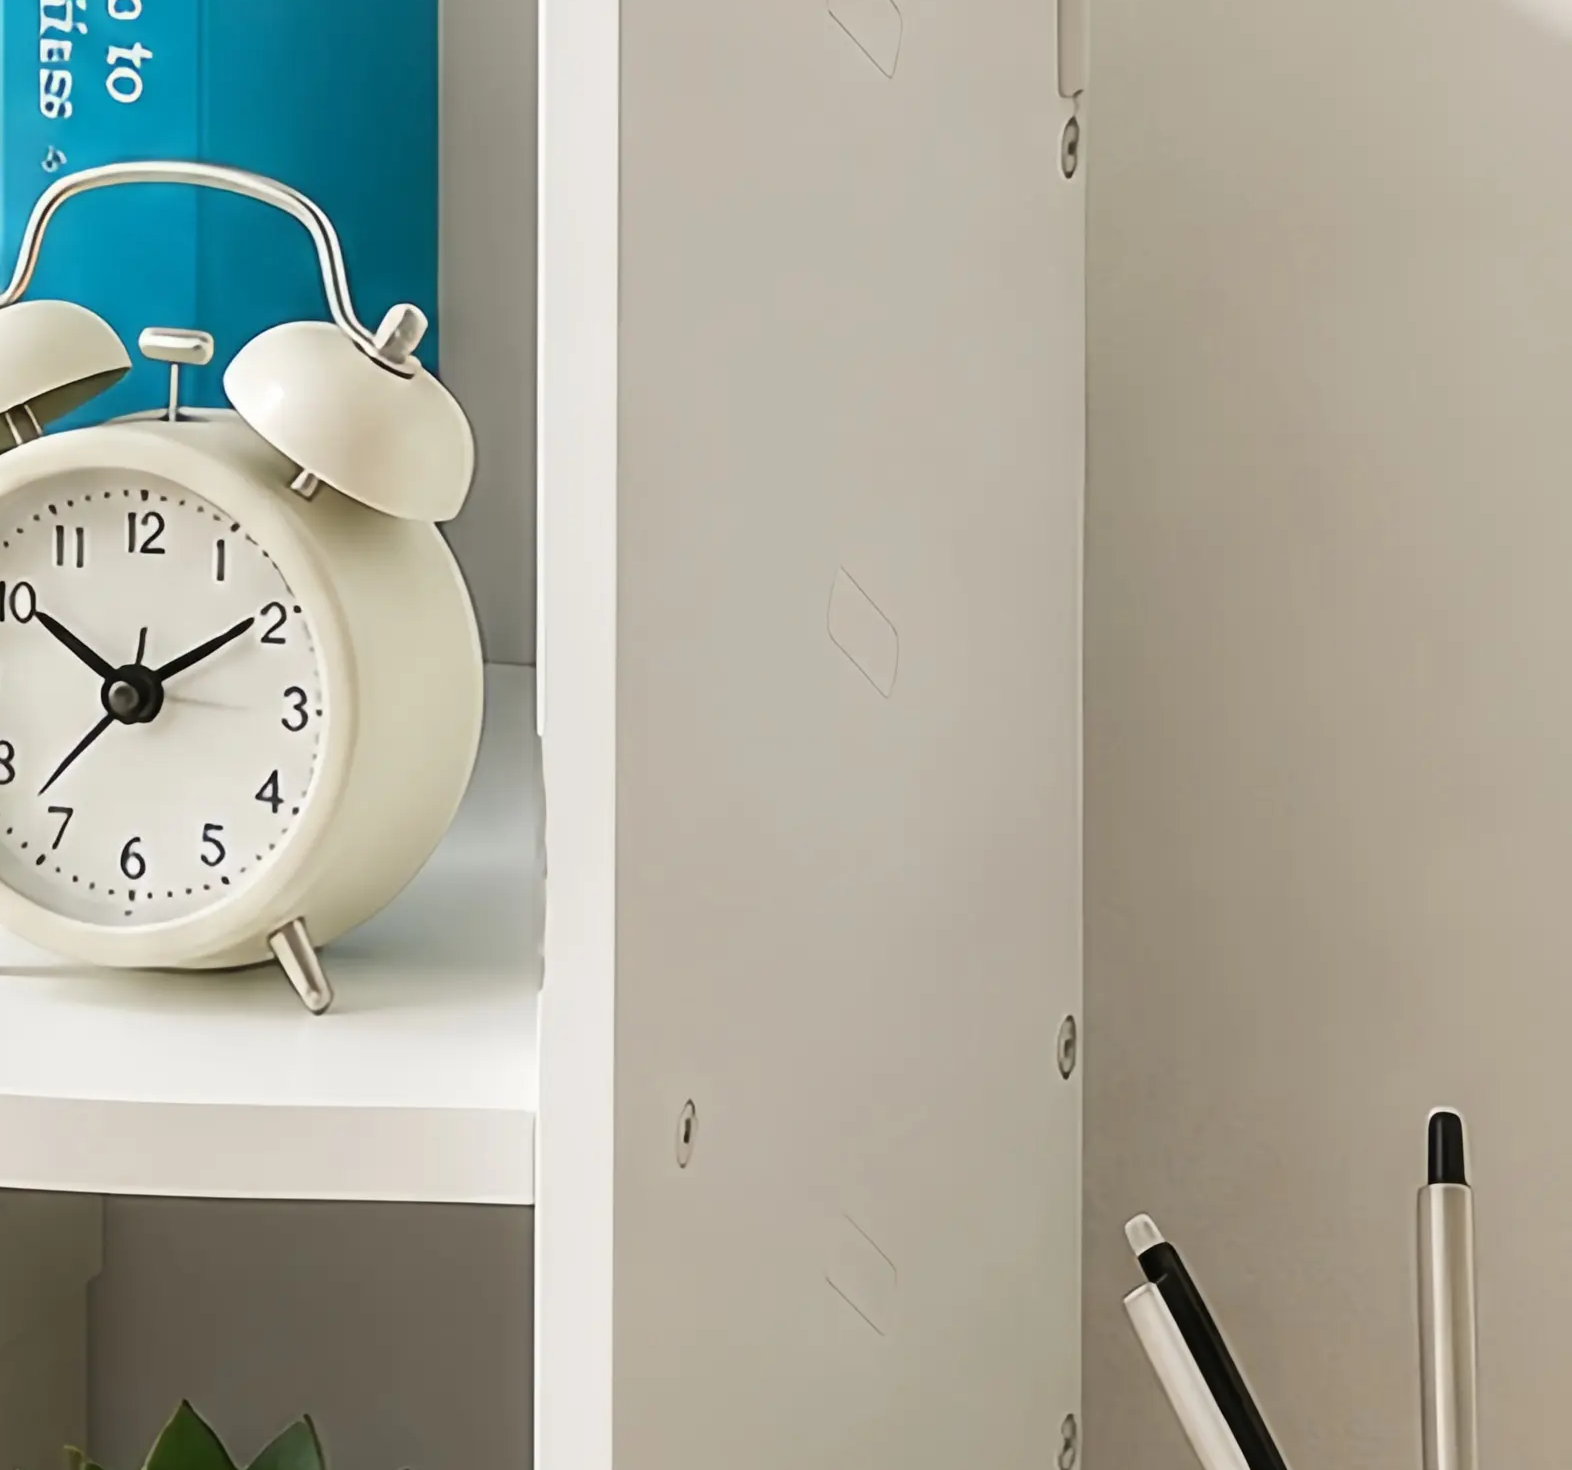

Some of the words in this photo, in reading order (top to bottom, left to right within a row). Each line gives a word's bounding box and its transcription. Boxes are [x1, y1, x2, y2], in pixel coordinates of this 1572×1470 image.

[105, 42, 154, 103] to
[55, 524, 84, 569] 11
[128, 511, 166, 555] 12
[260, 601, 287, 645] 2
[281, 687, 309, 732] 3
[254, 769, 284, 814] 4
[47, 805, 74, 850] 7
[200, 823, 226, 867] 5
[120, 836, 146, 880] 6
